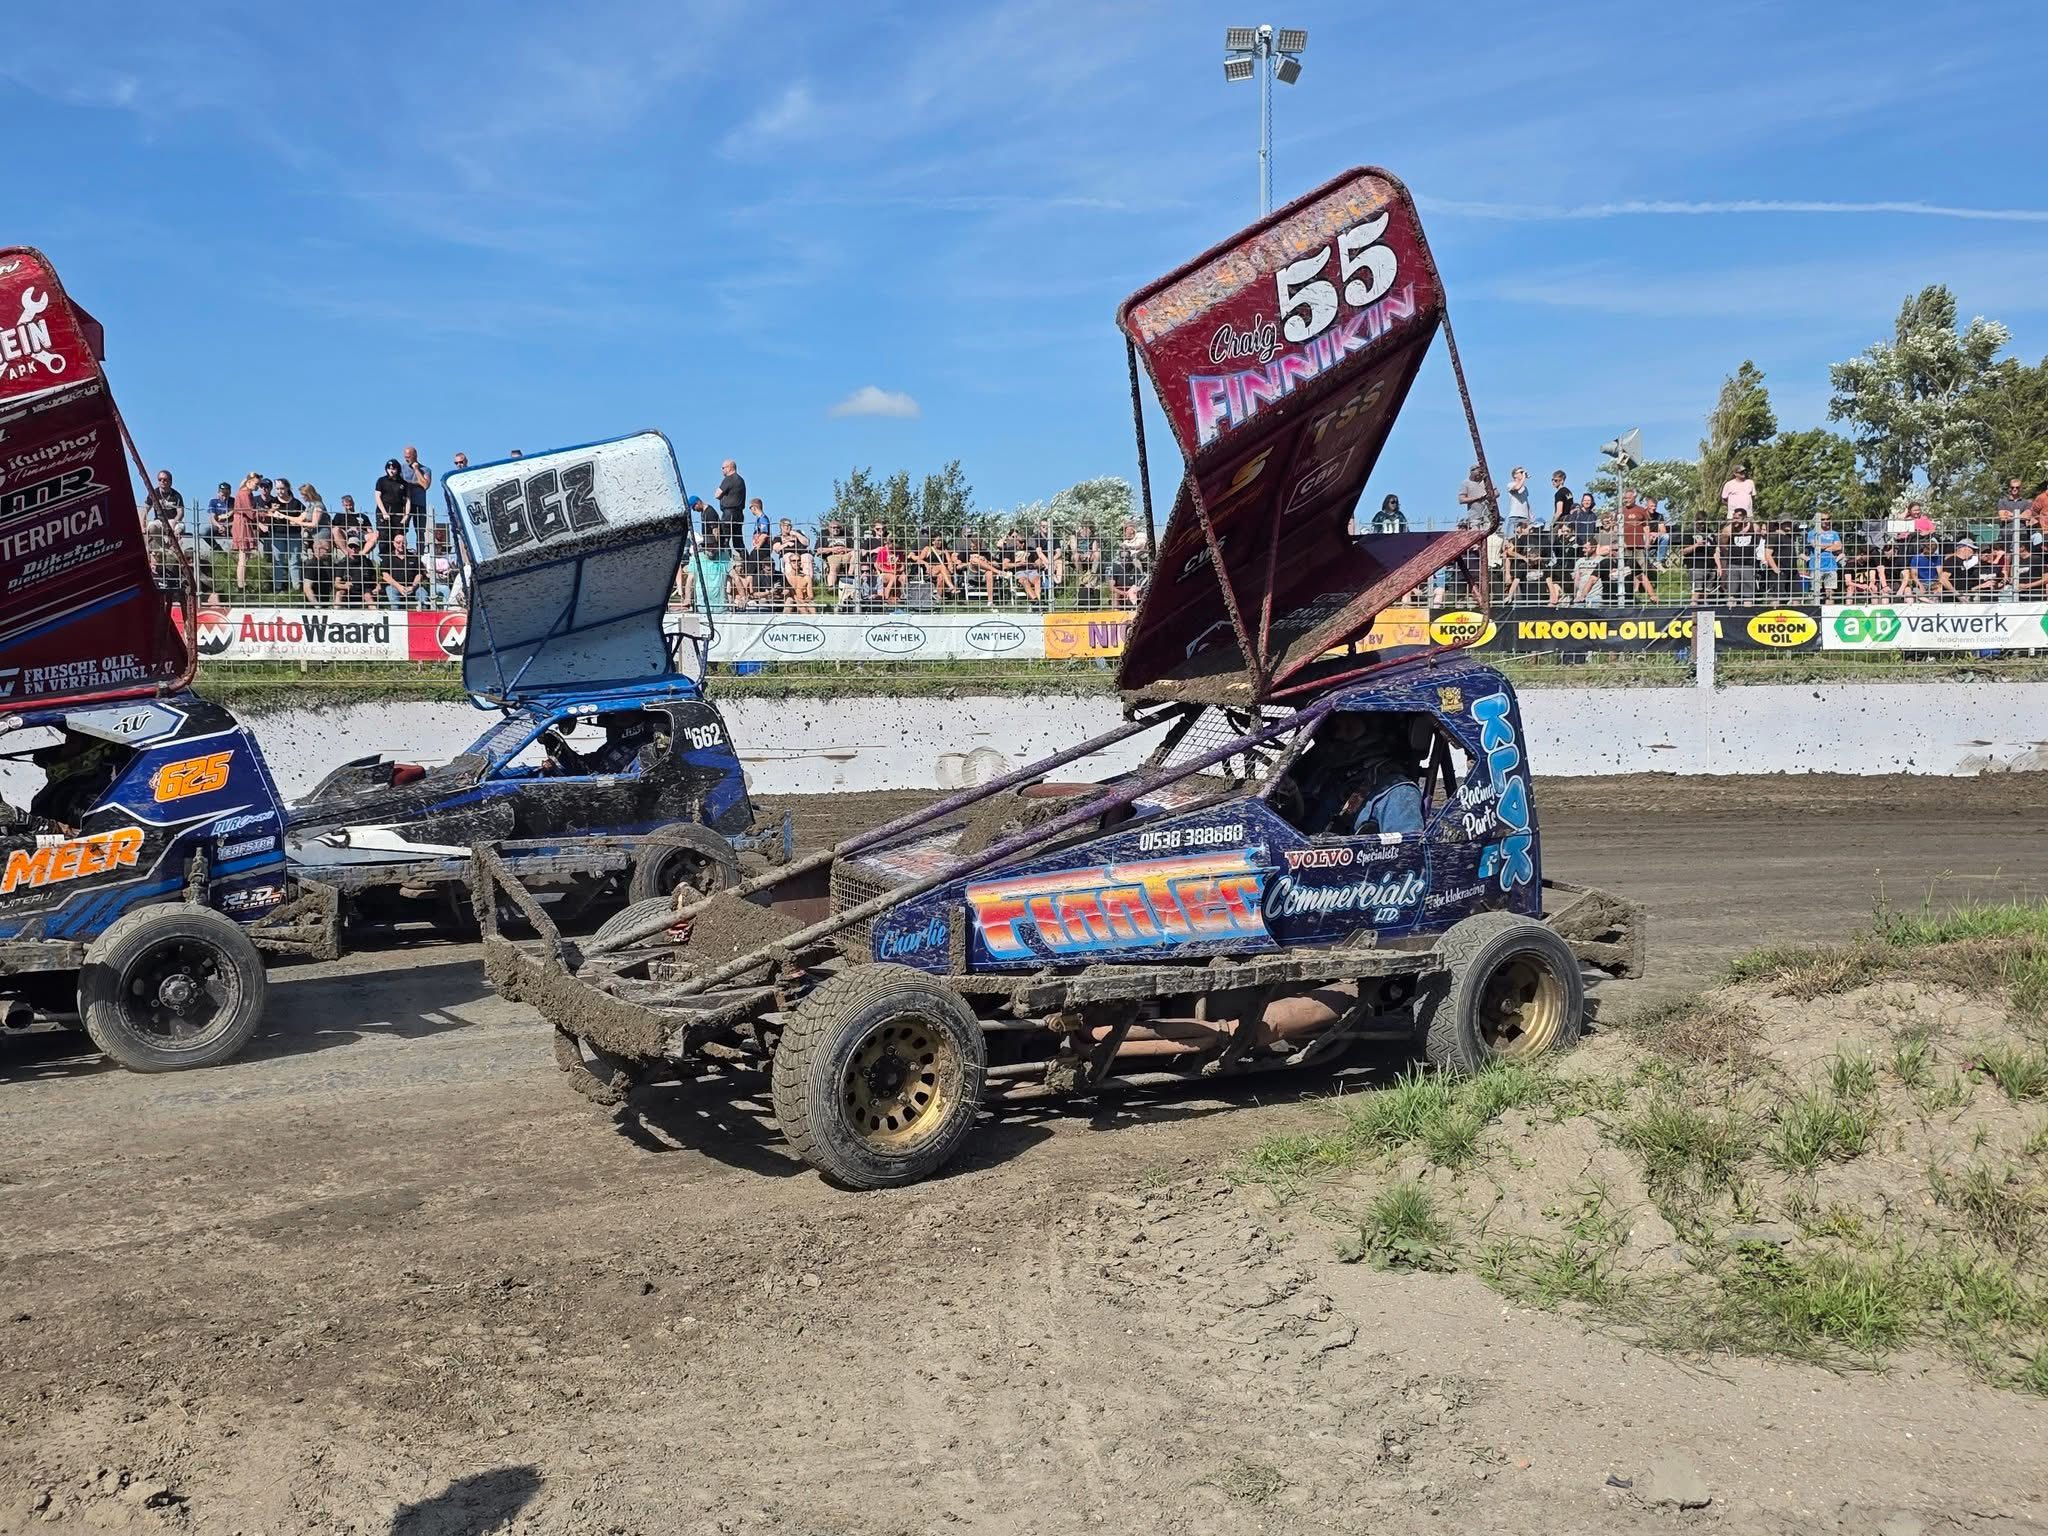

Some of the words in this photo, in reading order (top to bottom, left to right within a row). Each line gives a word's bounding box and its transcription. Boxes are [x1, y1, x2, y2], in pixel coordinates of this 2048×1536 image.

[1275, 211, 1398, 343] 55
[0, 318, 52, 361] EIN
[1208, 313, 1283, 364] Craig
[9, 361, 38, 380] APK
[1187, 283, 1415, 448] FINNIKIN
[239, 613, 390, 644] AutoWaard
[1758, 622, 1806, 634] KROON
[1770, 633, 1793, 644] OIL
[1907, 612, 2009, 634] vakwerk
[24, 660, 97, 683] FRIESCHE
[102, 654, 140, 670] OLIE-
[24, 682, 44, 695] EN
[49, 665, 148, 692] VERFHANDEL
[1456, 780, 1496, 812] Racing
[1462, 806, 1497, 841] Parts
[1140, 830, 1181, 851] 01538
[0, 826, 145, 895] MEER
[1285, 848, 1354, 869] VOLVO
[1356, 846, 1400, 866] Specialists
[1265, 869, 1426, 919] Commercials
[881, 917, 946, 960] Charlie
